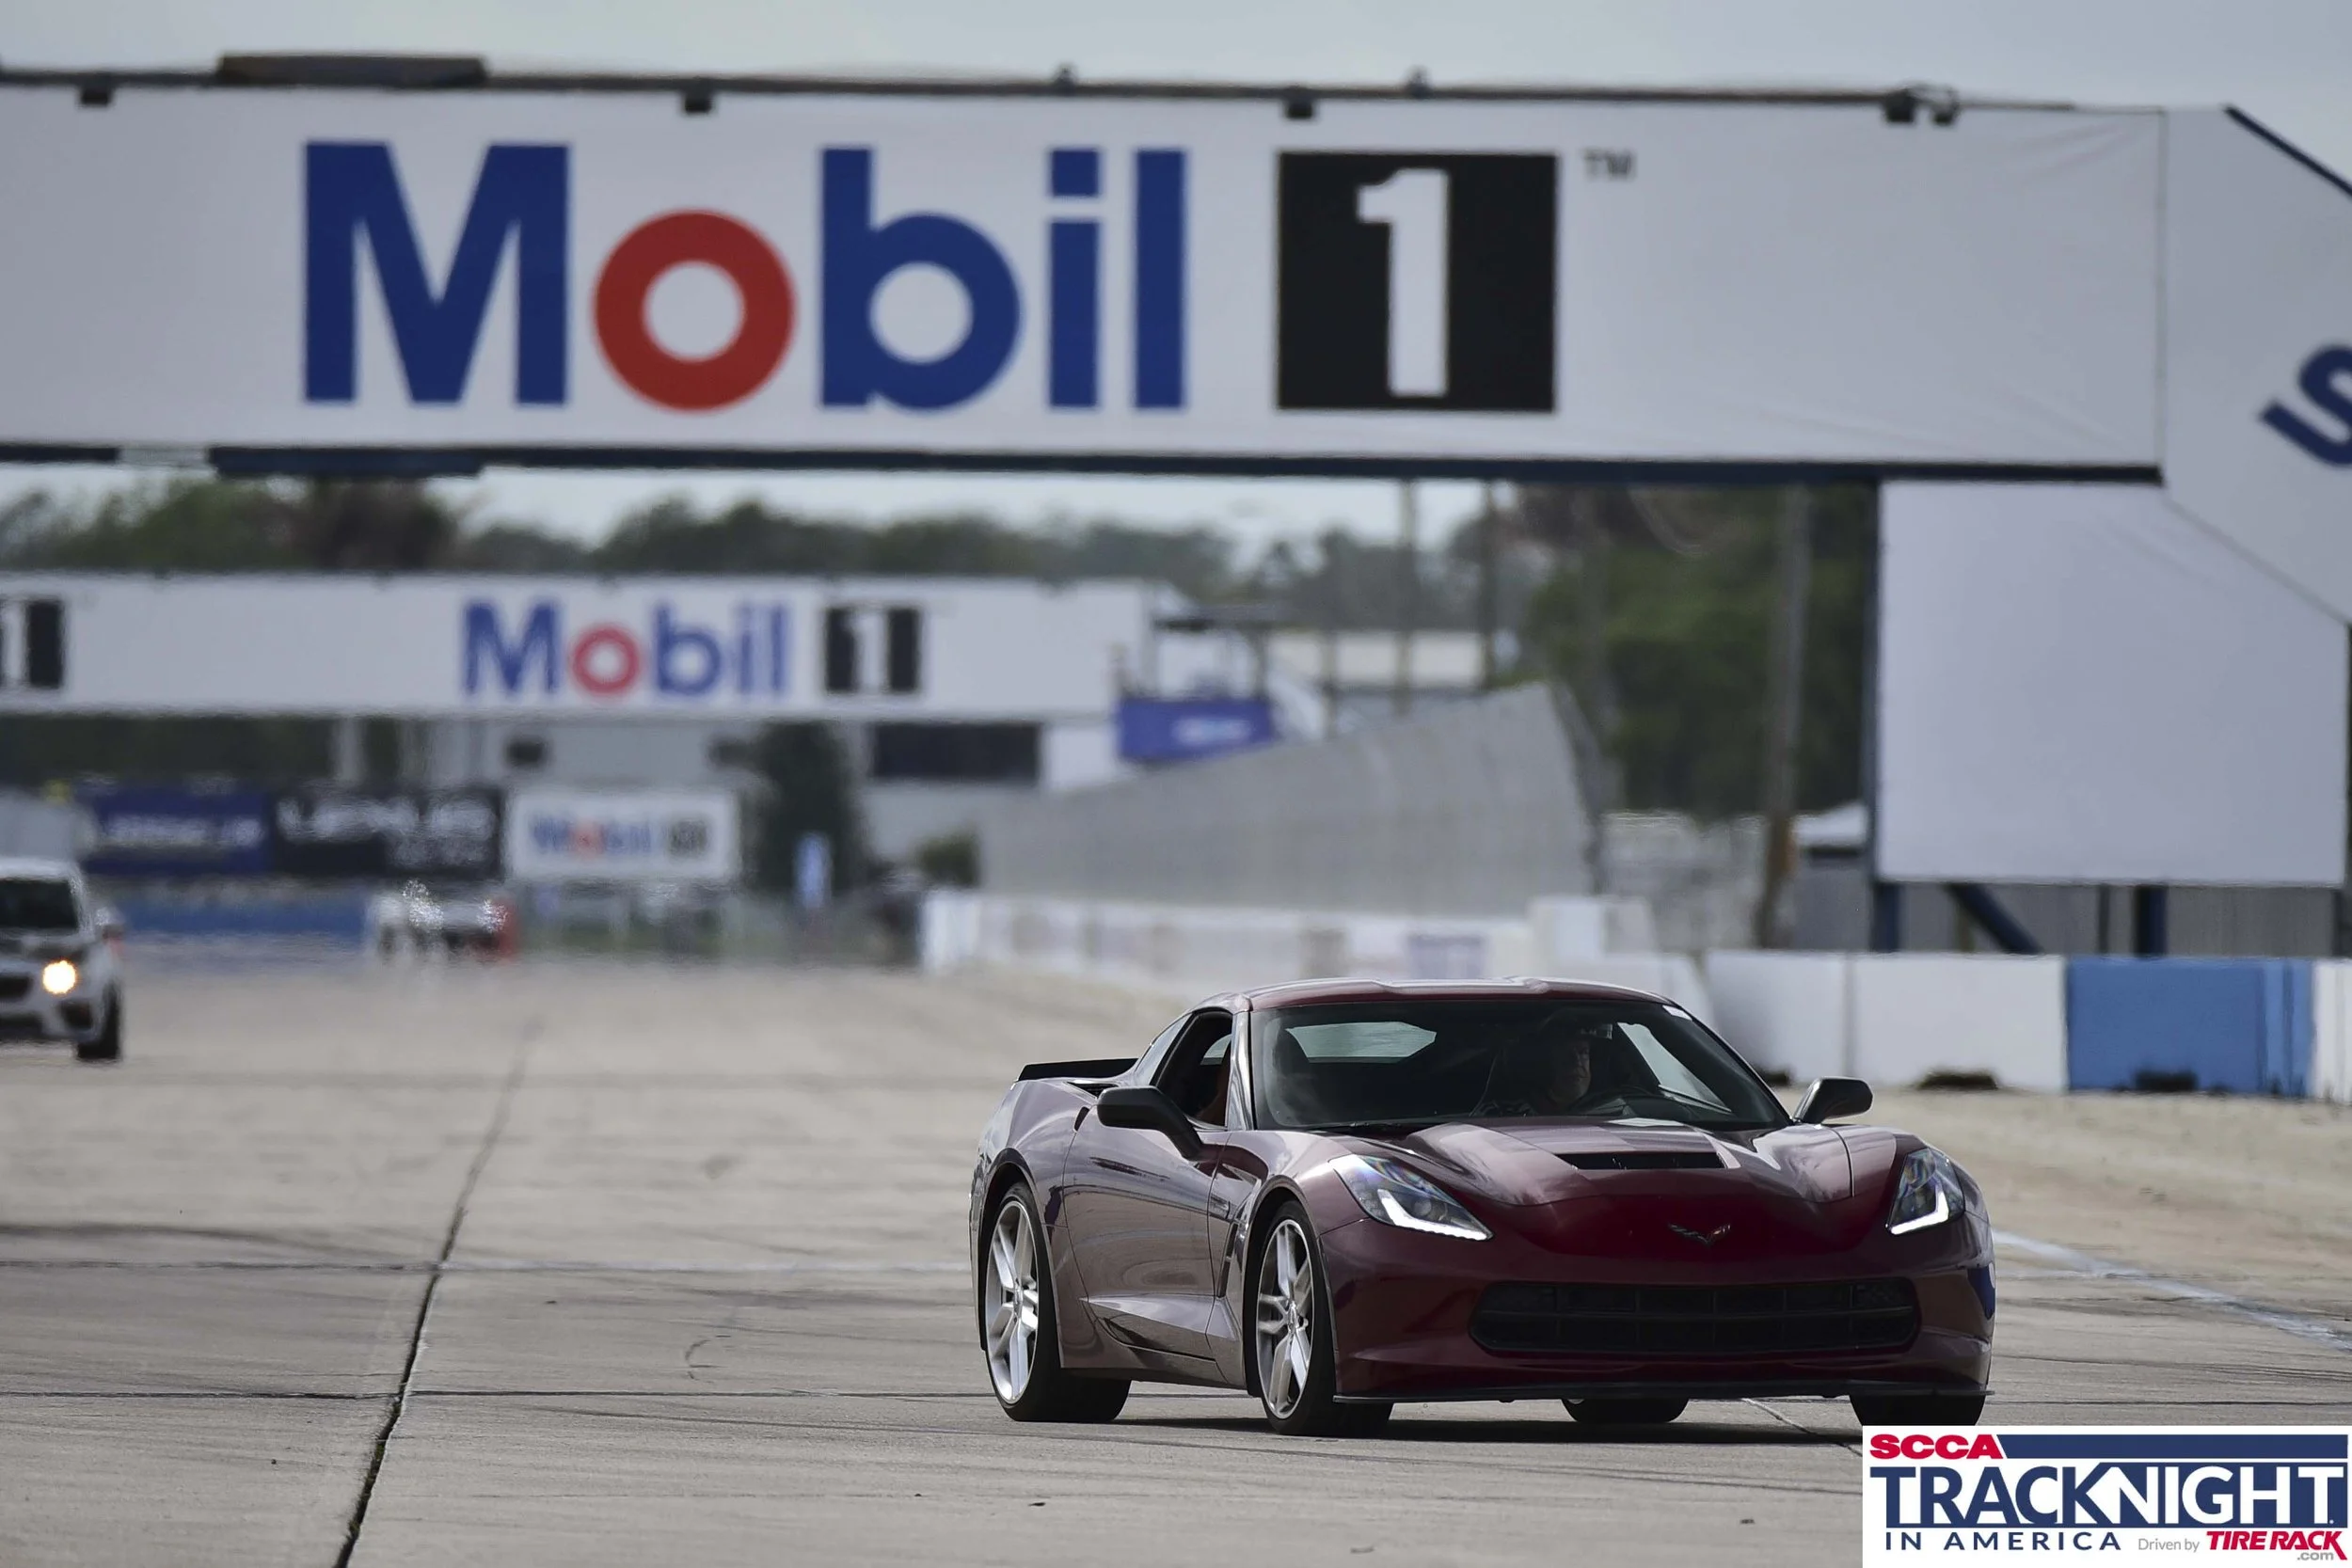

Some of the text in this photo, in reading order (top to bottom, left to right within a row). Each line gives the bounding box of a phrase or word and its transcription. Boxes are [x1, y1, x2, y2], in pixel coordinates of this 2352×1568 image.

[305, 141, 1633, 410] Mobil 1 TM
[463, 599, 788, 698] Mobil
